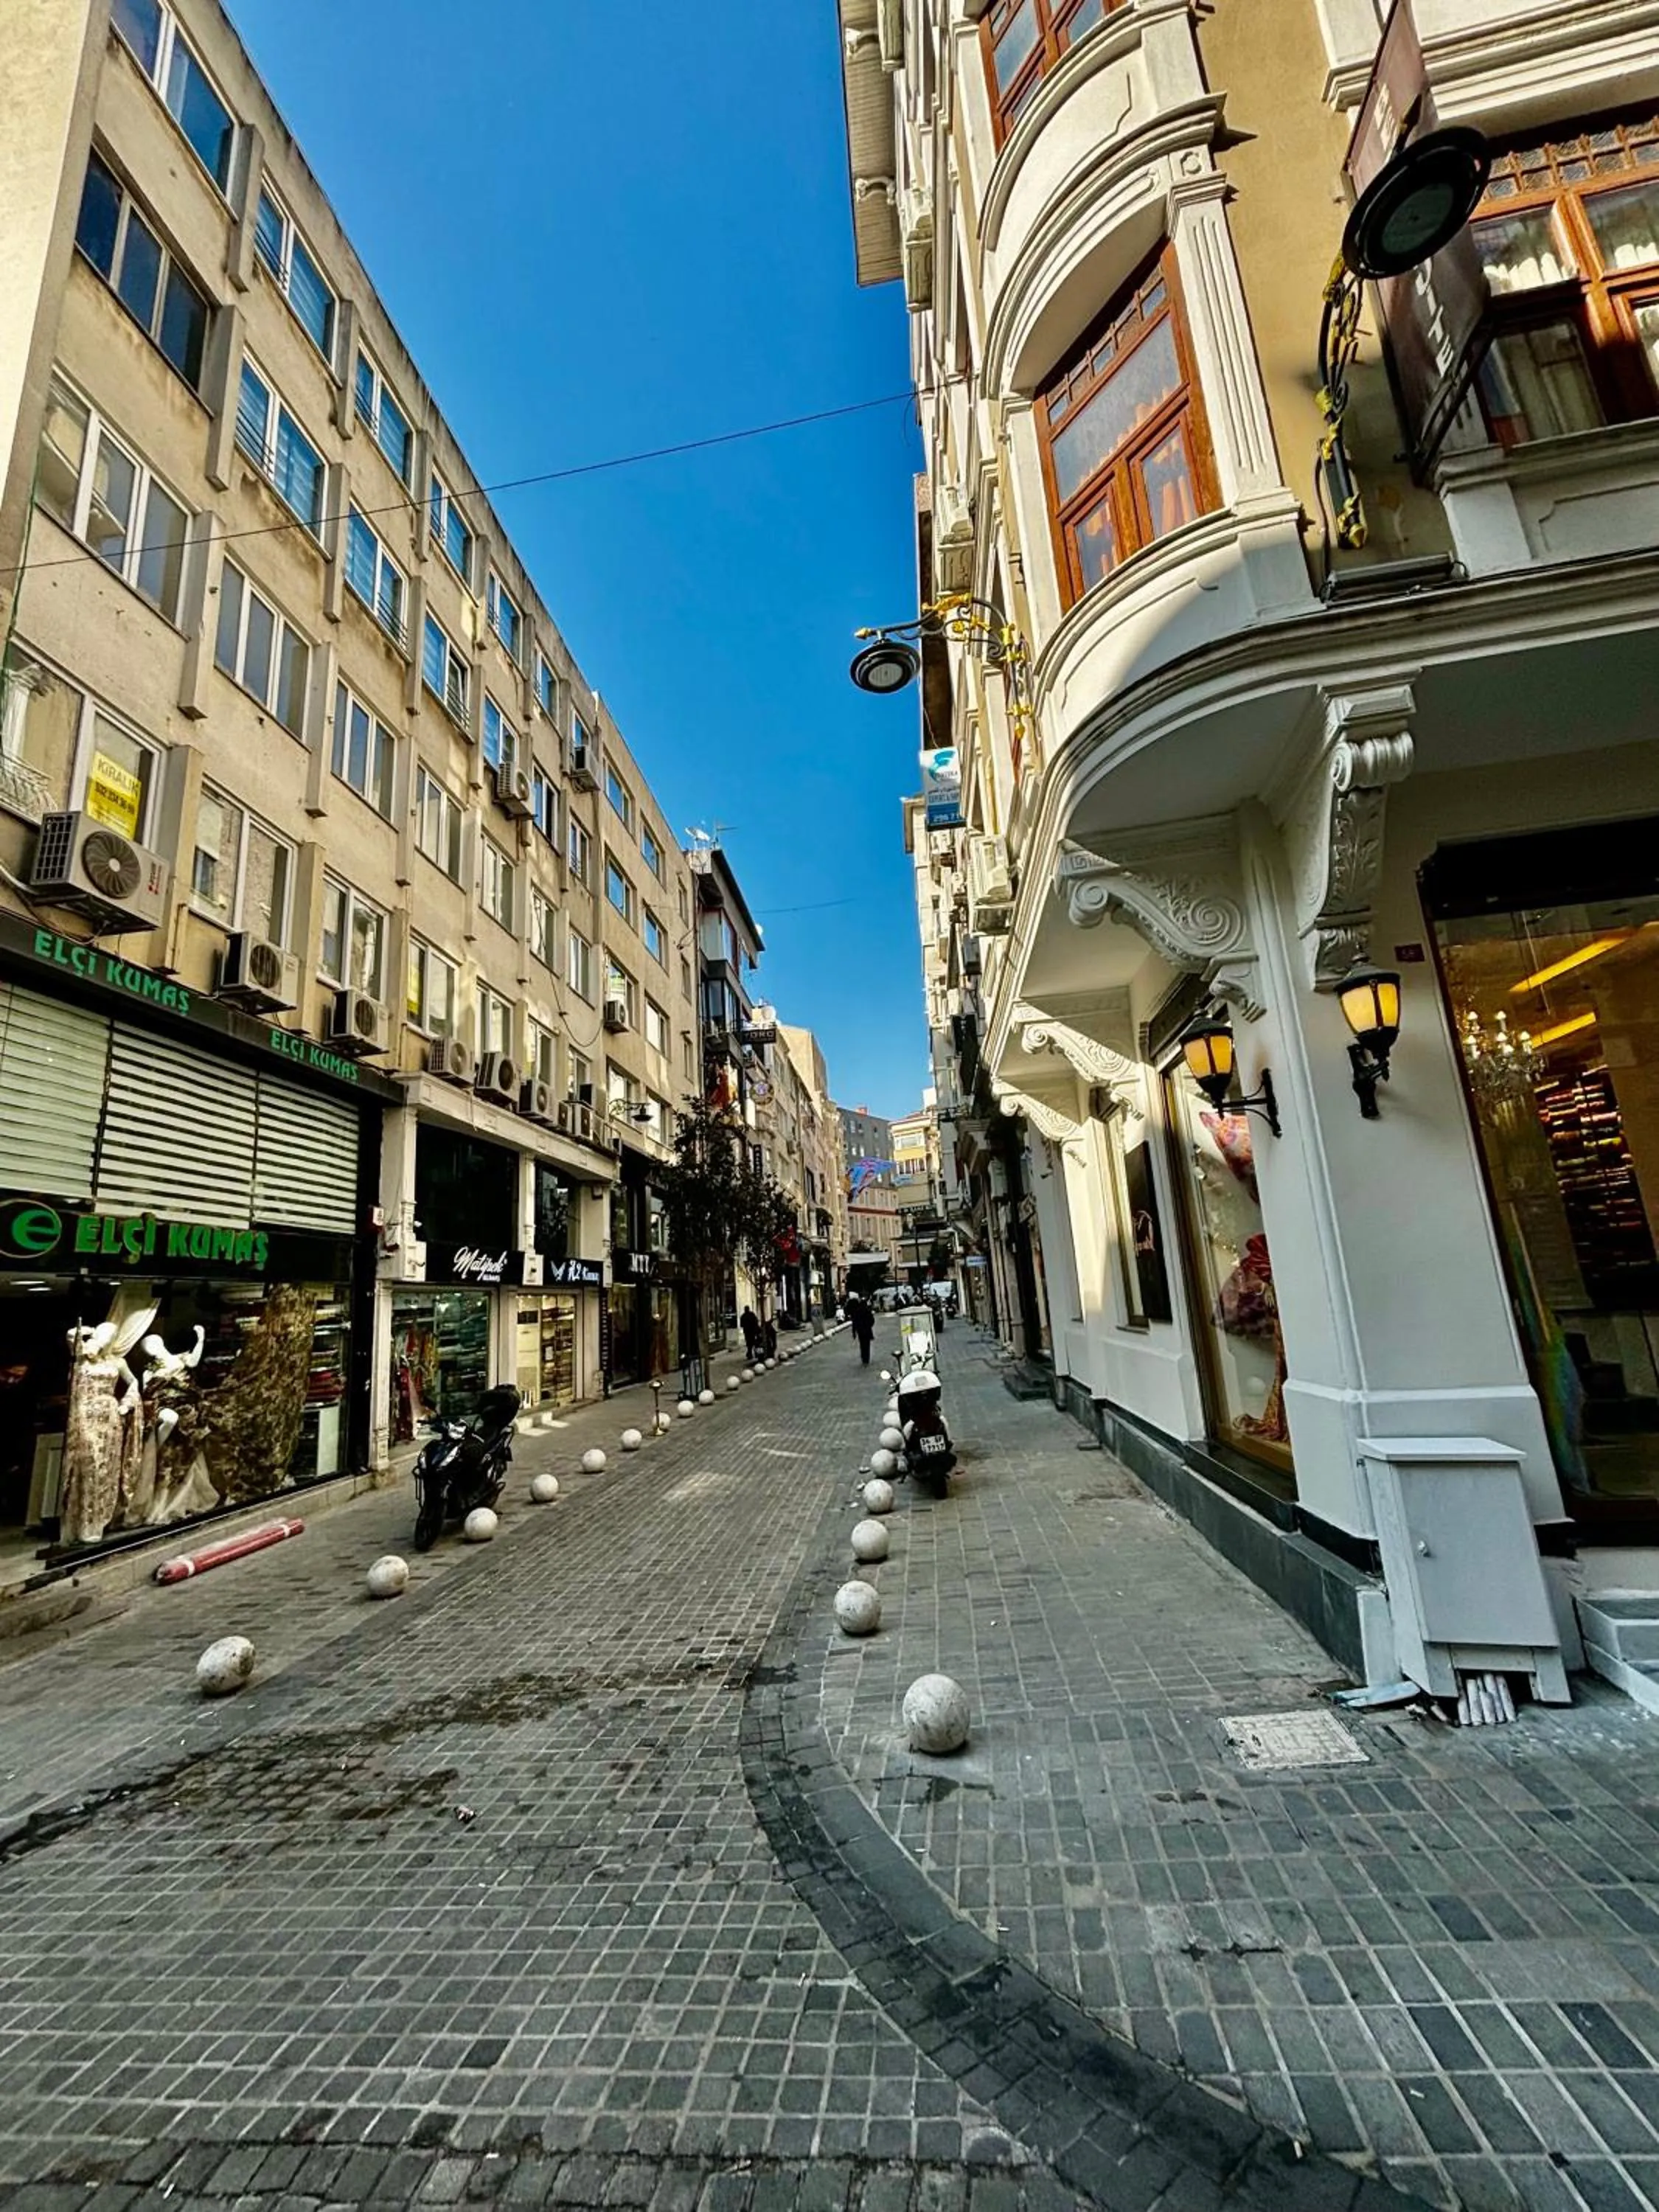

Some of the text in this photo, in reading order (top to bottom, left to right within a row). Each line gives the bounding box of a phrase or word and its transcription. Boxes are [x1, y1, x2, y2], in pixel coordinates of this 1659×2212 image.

[106, 959, 189, 1017] KUMAŞ
[310, 1046, 358, 1085] KUMAŞ
[167, 1222, 268, 1270] KUMAŞ
